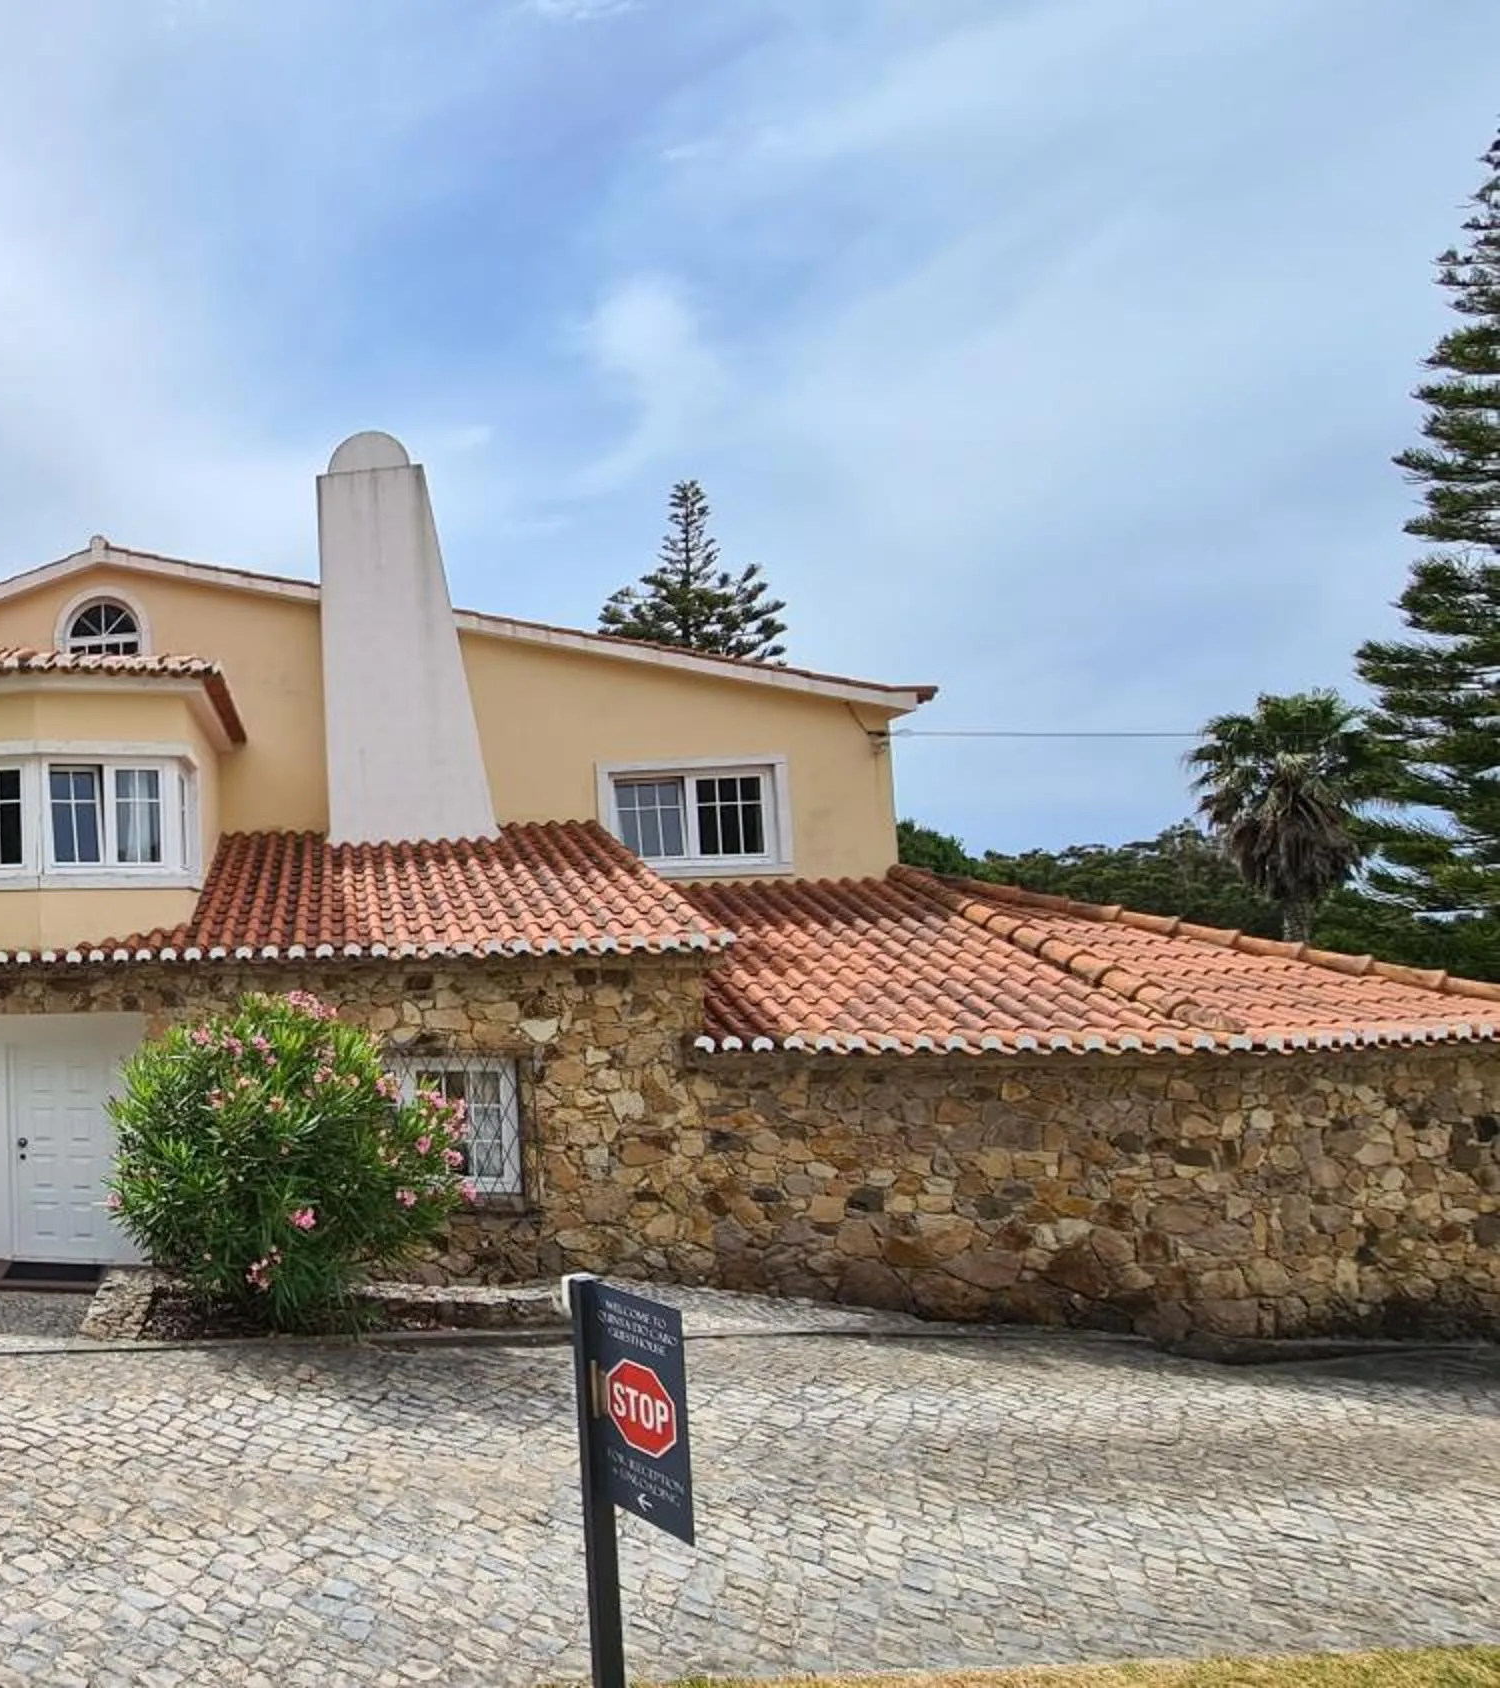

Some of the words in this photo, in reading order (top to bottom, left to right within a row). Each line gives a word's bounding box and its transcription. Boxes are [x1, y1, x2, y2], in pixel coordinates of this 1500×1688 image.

[597, 1309, 631, 1331] QUINTA
[633, 1322, 649, 1337] DO
[649, 1328, 678, 1347] CABO
[604, 1299, 652, 1324] WELCOME
[653, 1315, 667, 1329] TO
[606, 1326, 668, 1357] GUESTHOUSE
[613, 1381, 669, 1435] STOP
